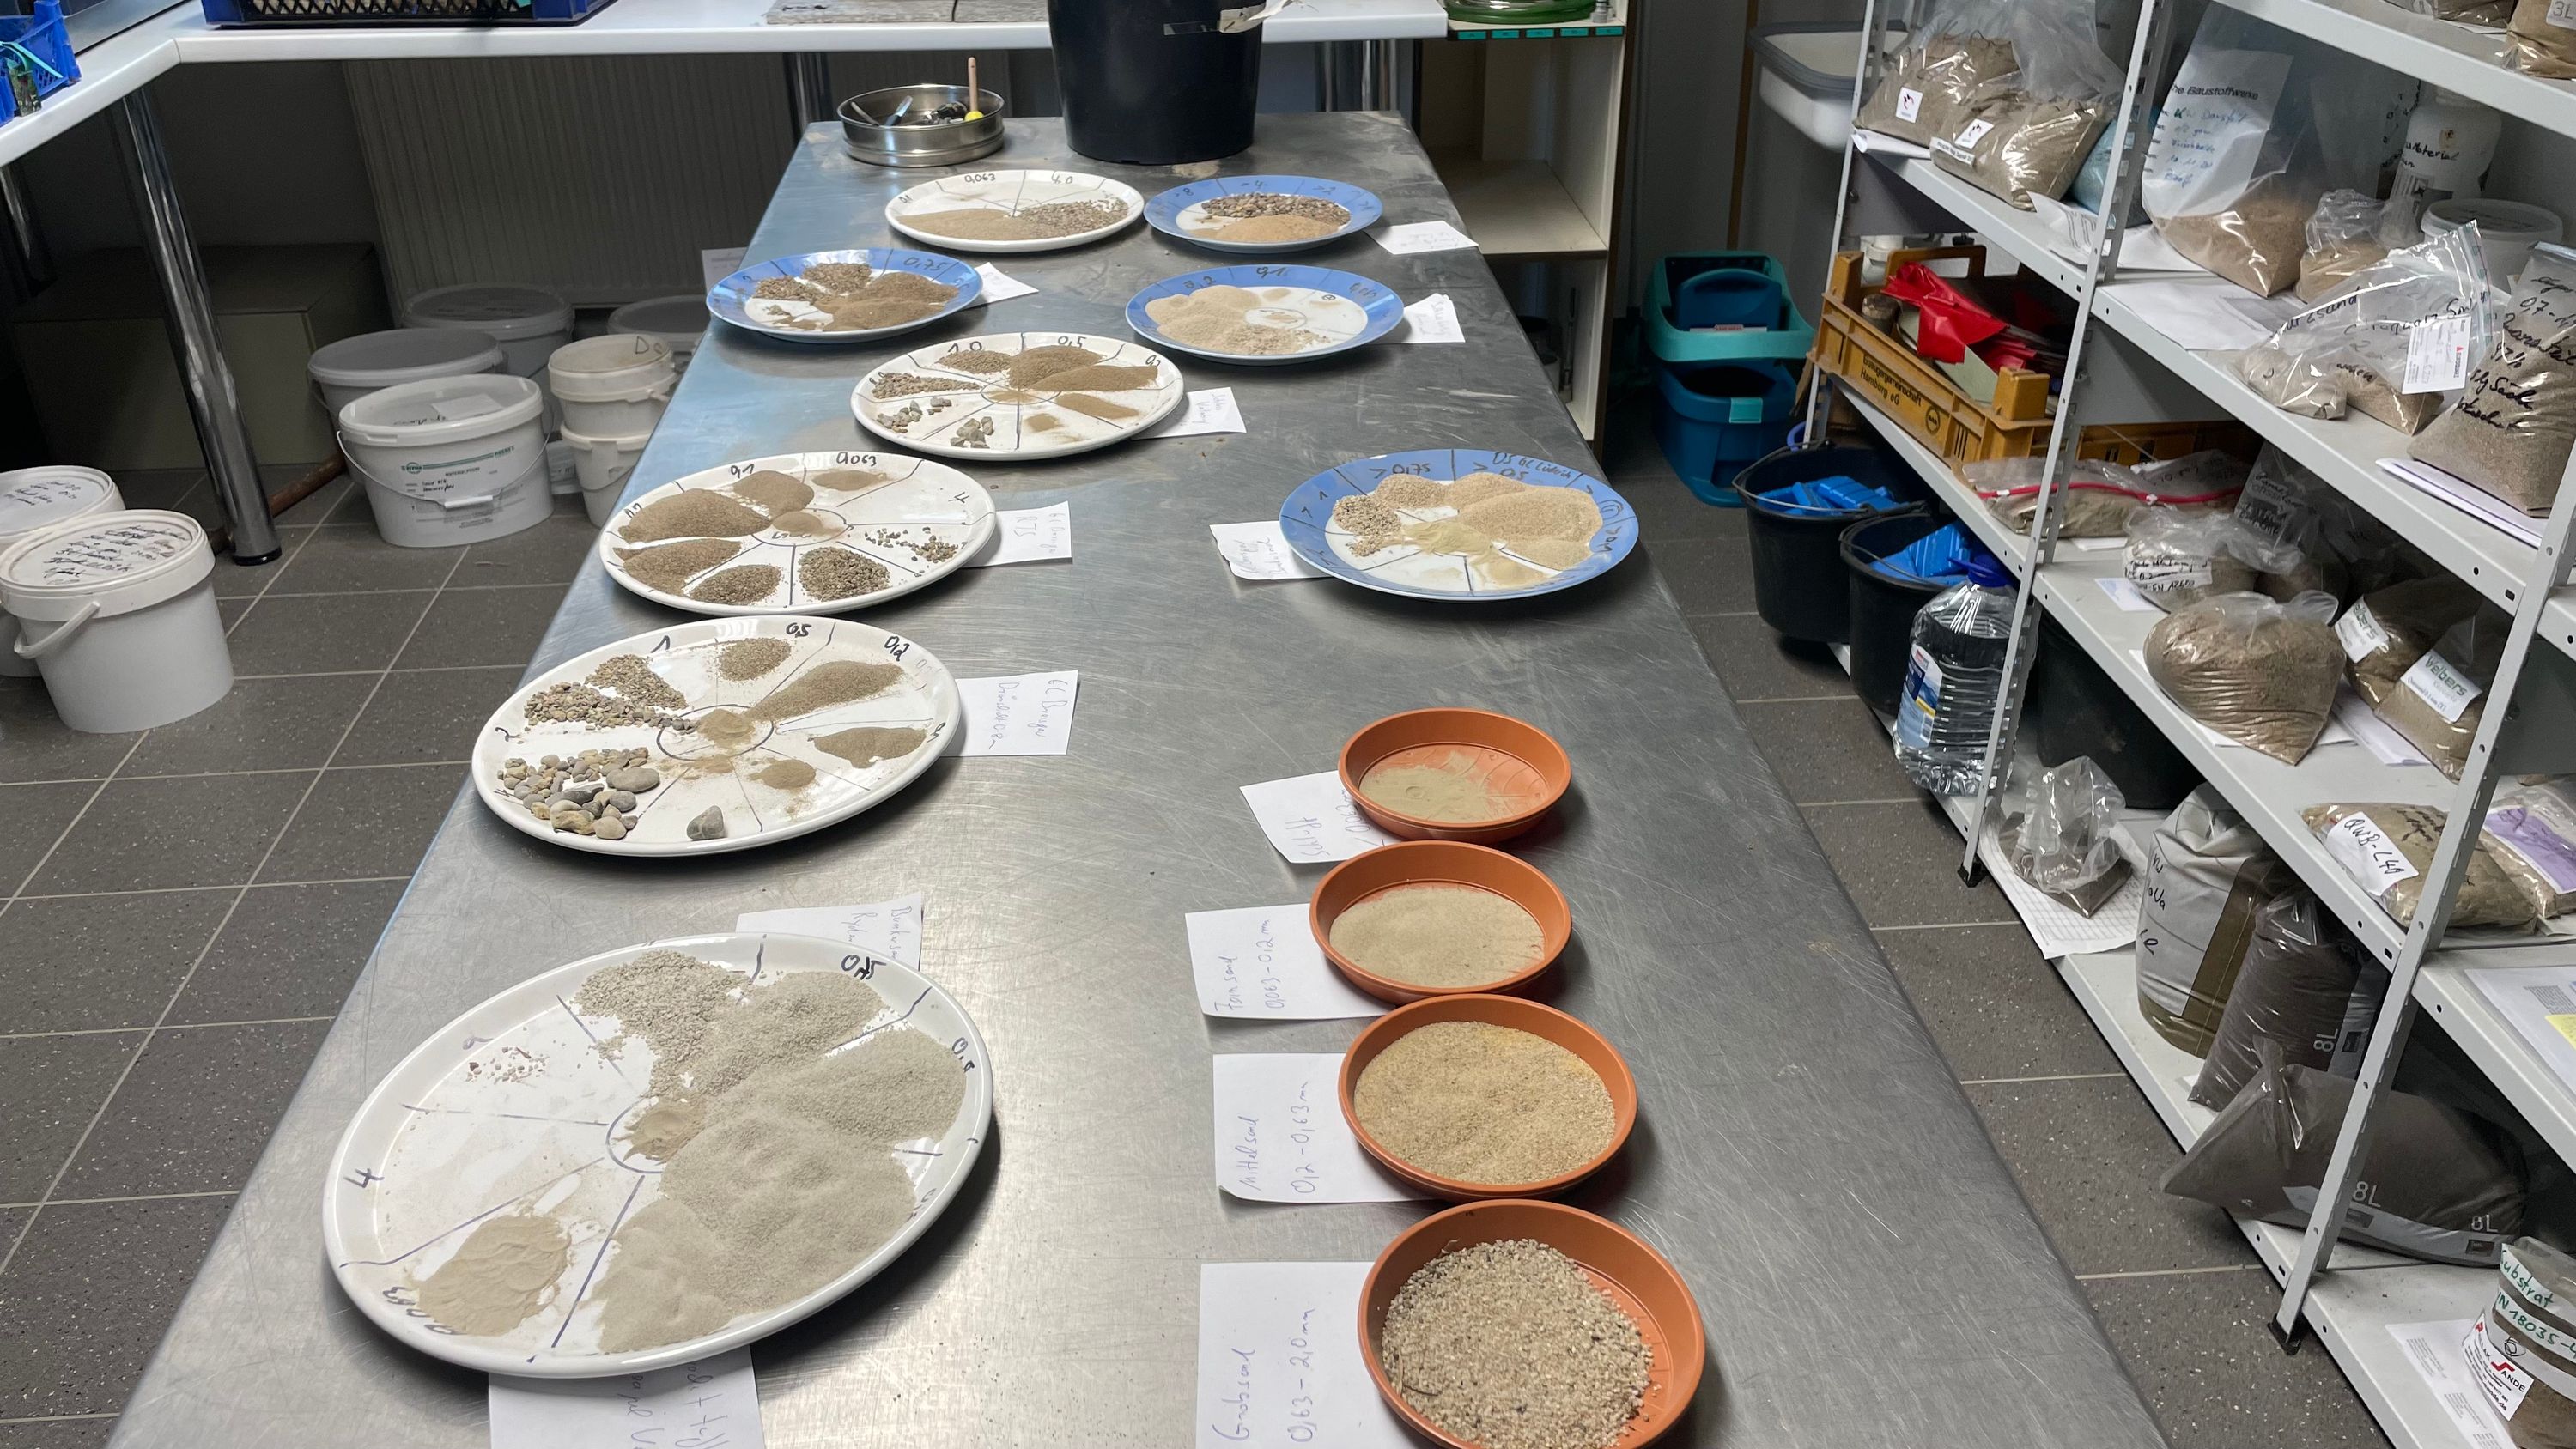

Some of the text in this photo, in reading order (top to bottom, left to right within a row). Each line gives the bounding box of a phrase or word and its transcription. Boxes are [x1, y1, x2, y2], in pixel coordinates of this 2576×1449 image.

[2553, 1, 2575, 19] 3L
[964, 173, 995, 183] 0,063
[1057, 335, 1088, 349] 0,5
[1860, 368, 1889, 399] Hamburg
[2424, 653, 2468, 697] Velbers
[2313, 1028, 2339, 1053] 8L
[2352, 1180, 2382, 1209] 8L
[2470, 1213, 2500, 1234] 8L
